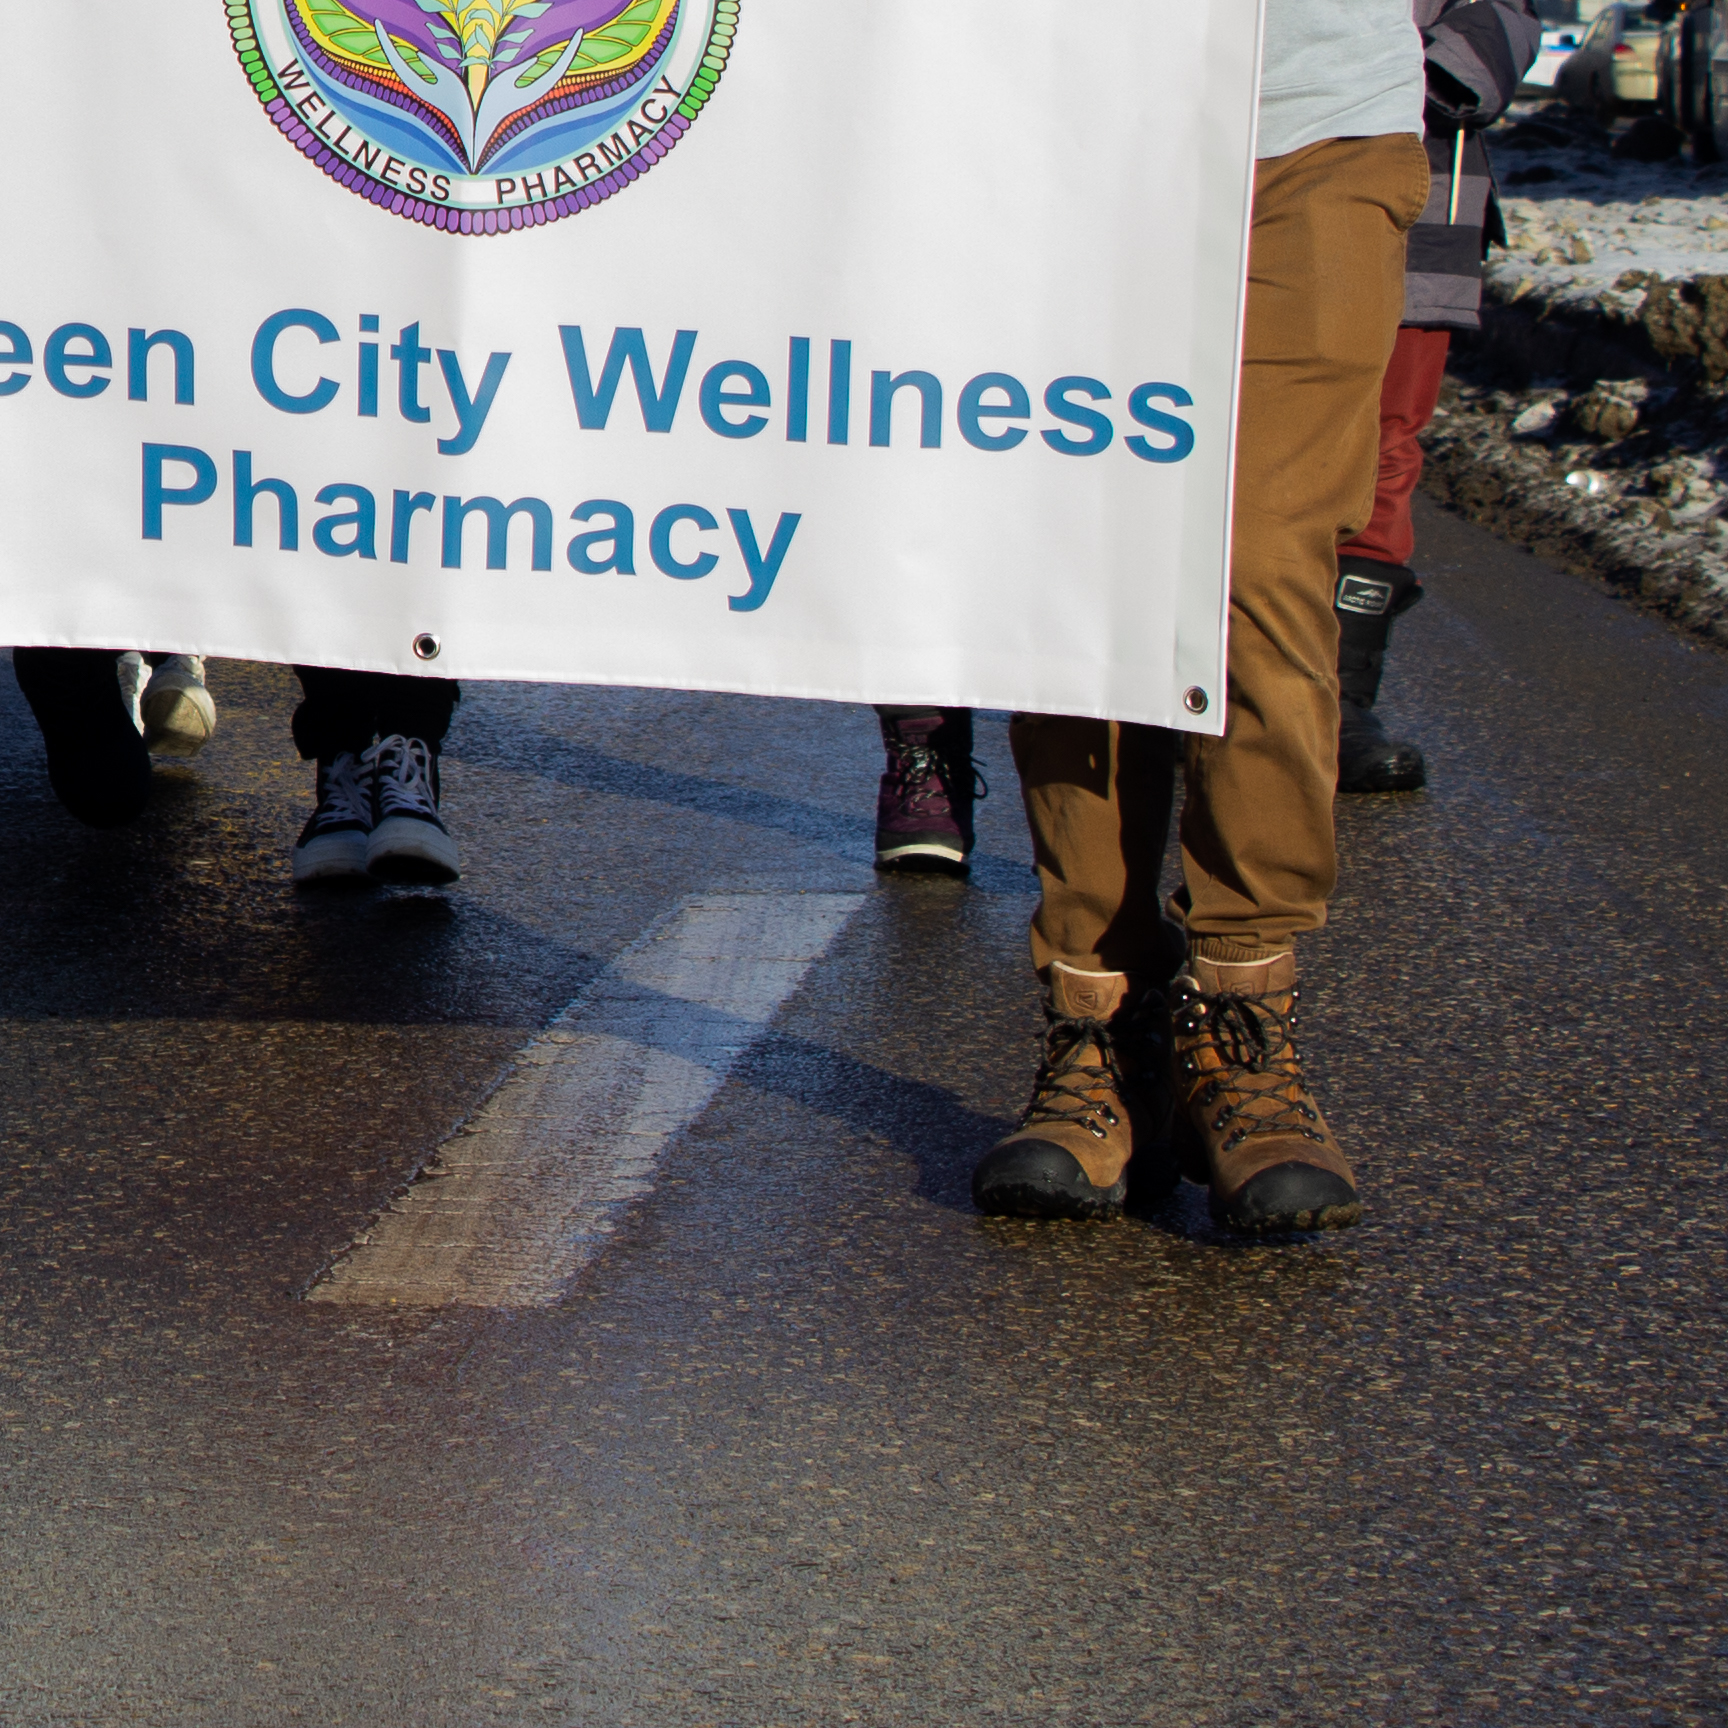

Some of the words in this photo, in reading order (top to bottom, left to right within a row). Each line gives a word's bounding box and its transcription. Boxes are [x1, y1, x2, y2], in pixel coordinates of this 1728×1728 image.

[276, 57, 452, 203] WELLNESS
[495, 75, 682, 205] PHARMACY
[248, 306, 512, 456] City
[556, 324, 1198, 466] Wellness
[139, 441, 804, 613] Pharmacy
